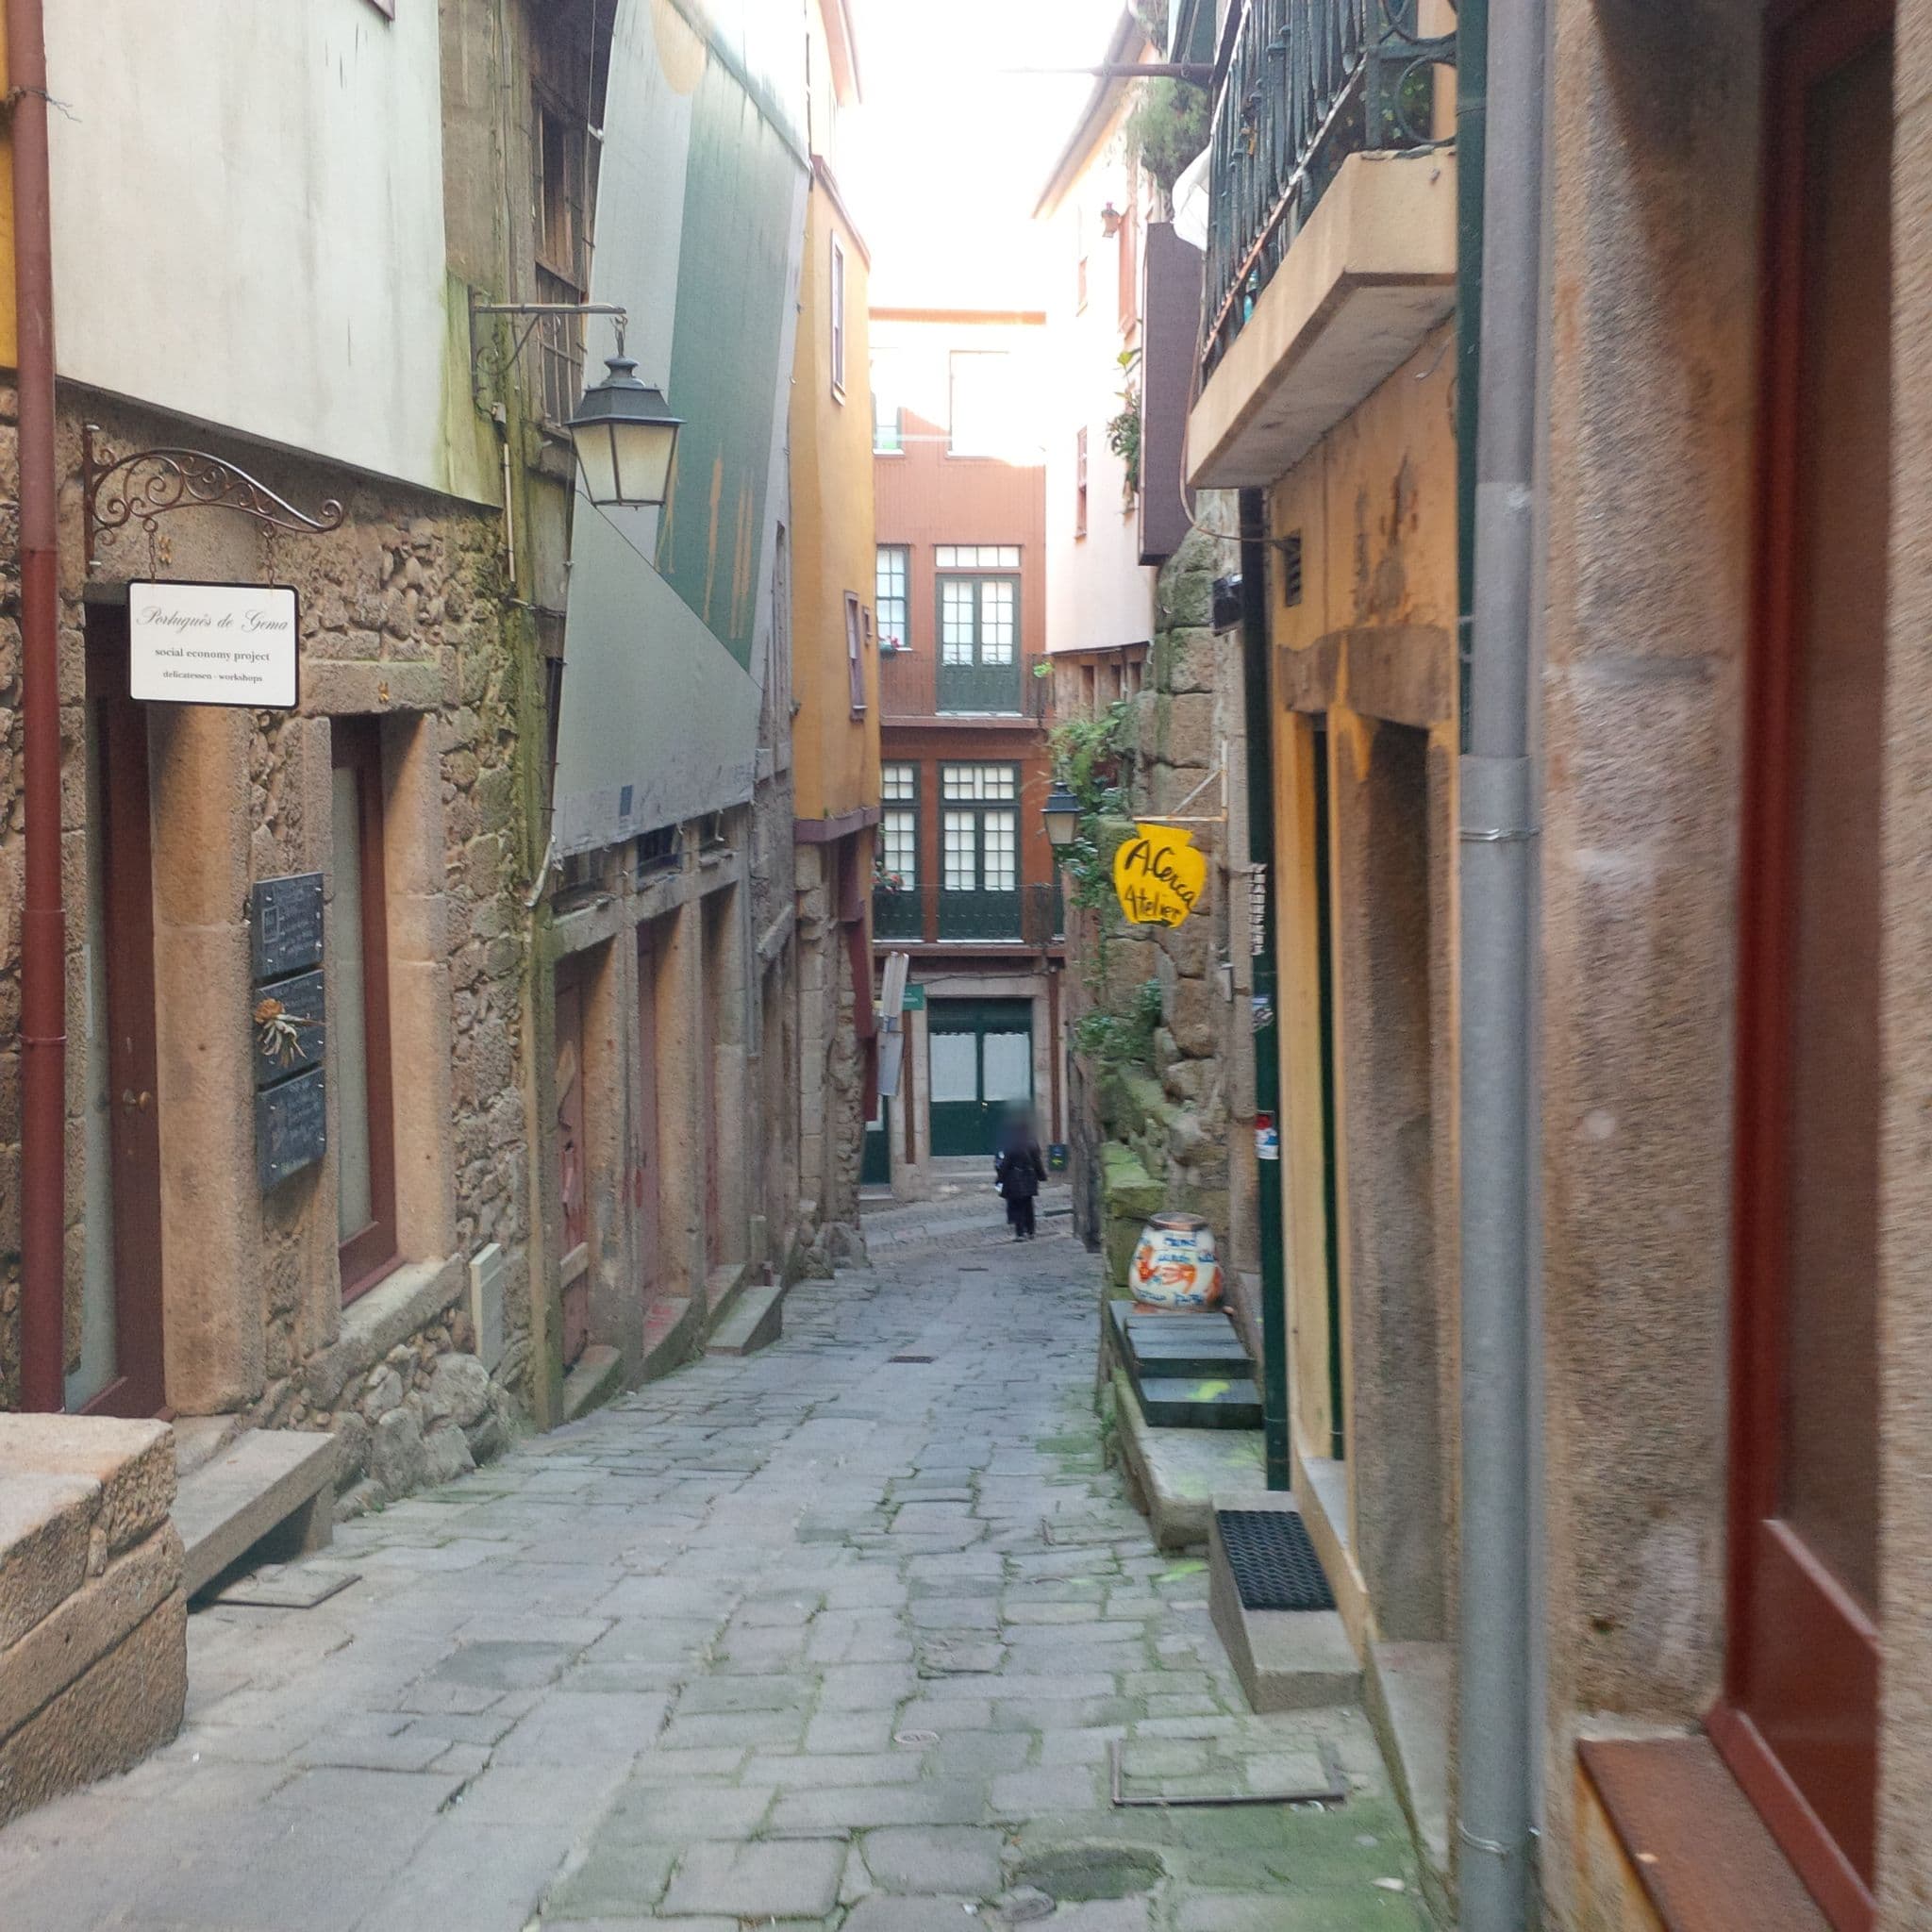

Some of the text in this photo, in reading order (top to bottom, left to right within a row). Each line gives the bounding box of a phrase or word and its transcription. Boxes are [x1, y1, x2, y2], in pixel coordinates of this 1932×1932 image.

[136, 606, 289, 633] Português de Gema
[155, 647, 271, 663] social economy project
[162, 670, 263, 684] delicatessen workshops
